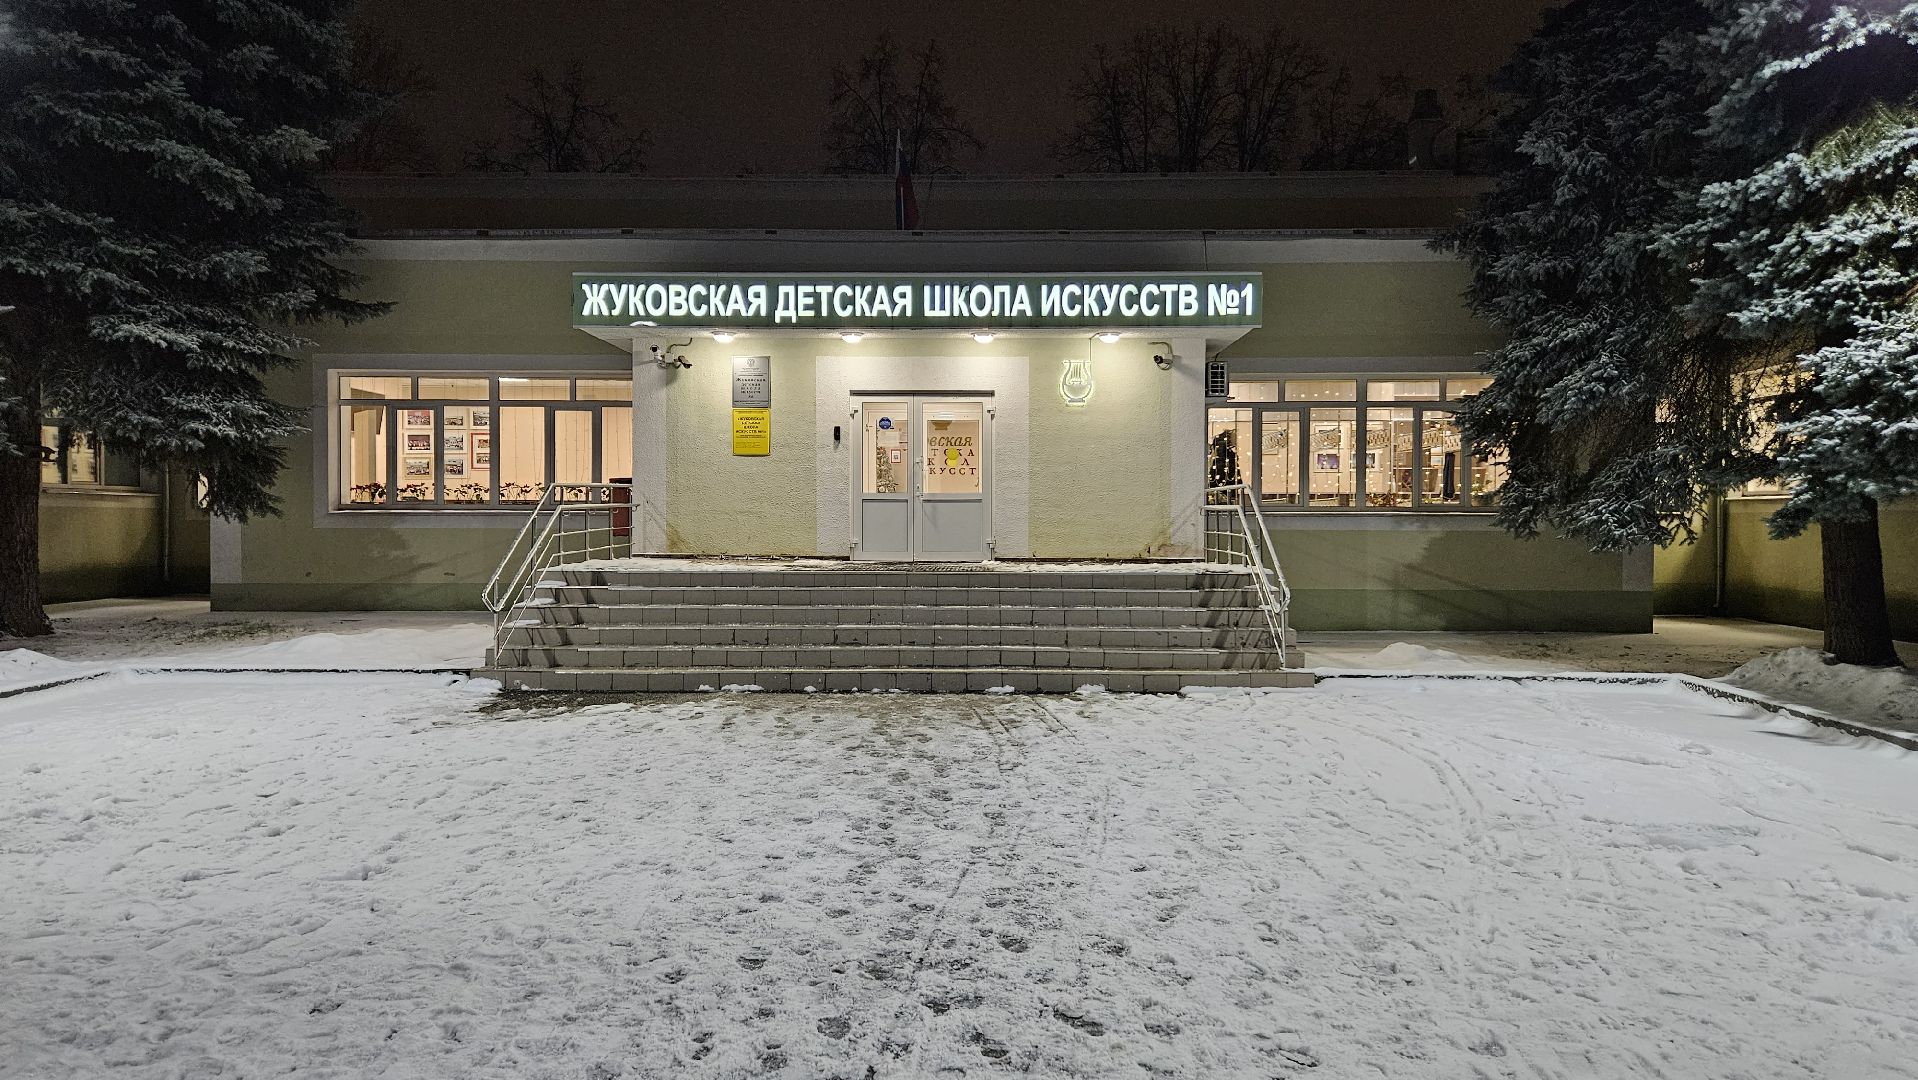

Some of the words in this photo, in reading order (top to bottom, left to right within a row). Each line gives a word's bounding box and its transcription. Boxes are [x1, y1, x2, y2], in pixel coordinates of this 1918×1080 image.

[582, 283, 767, 317] ЖУКОВСКАЯ
[775, 284, 913, 324] ДЕТСКАЯ
[923, 283, 1033, 317] ШКОЛА
[1041, 283, 1199, 317] ИСКУССТВ
[1207, 282, 1253, 316] №1
